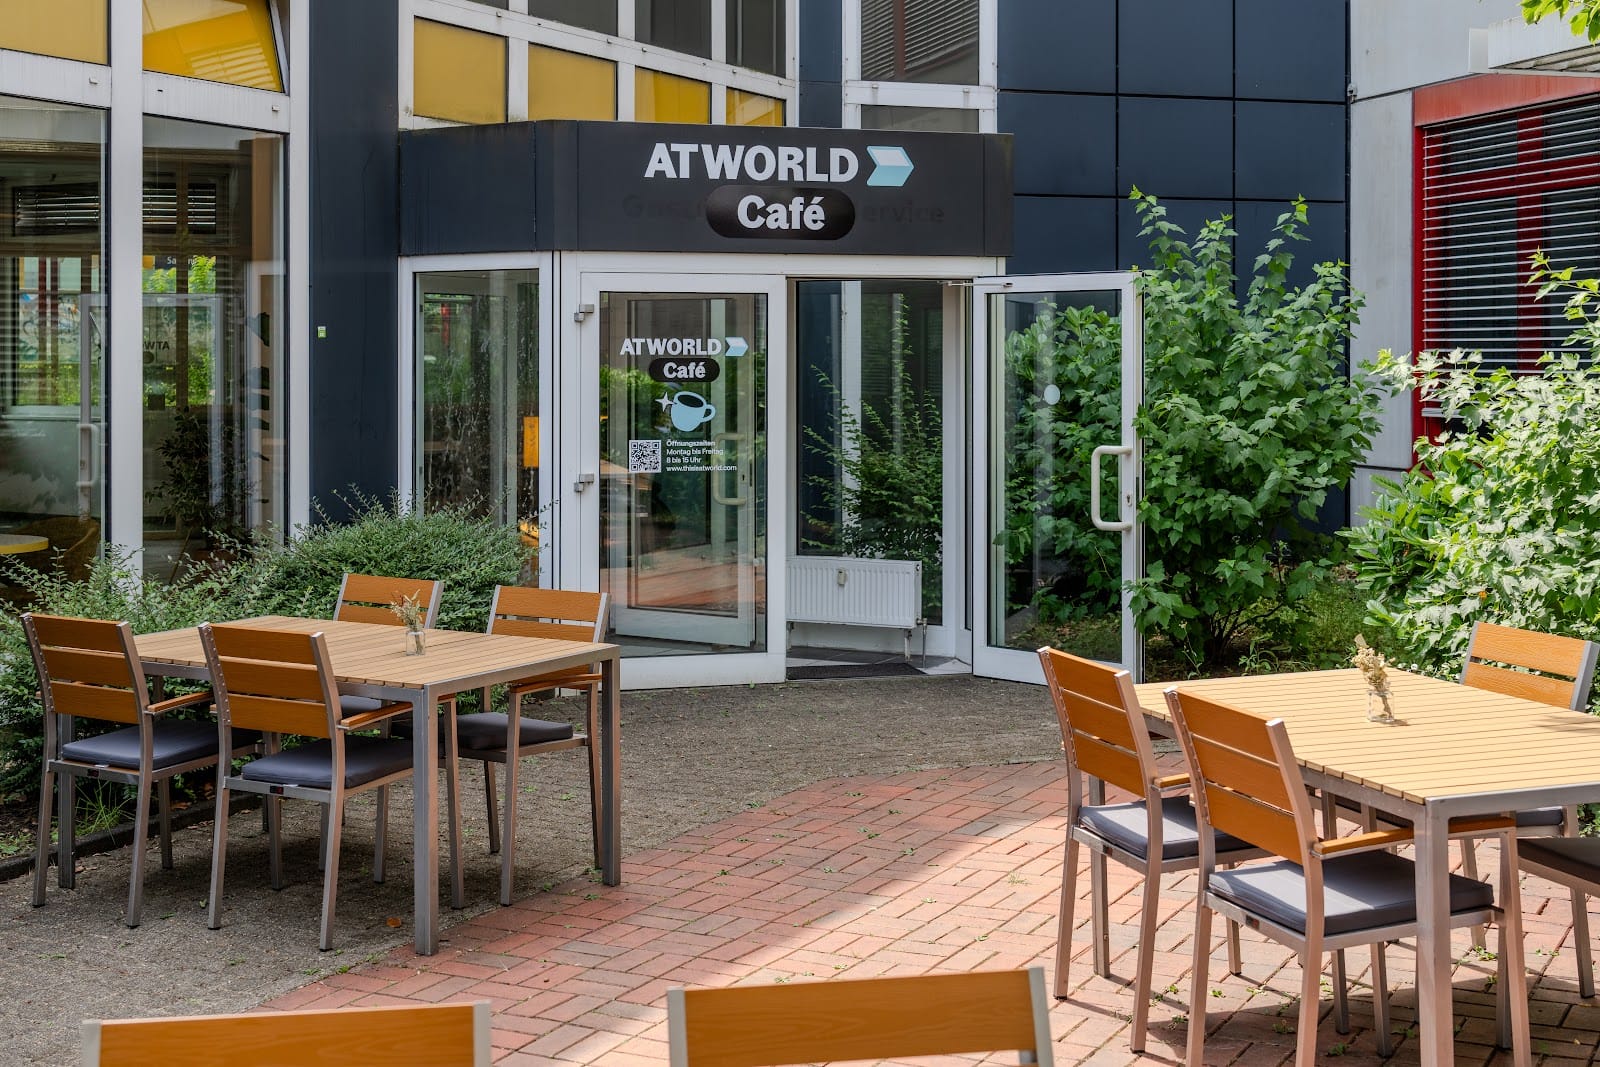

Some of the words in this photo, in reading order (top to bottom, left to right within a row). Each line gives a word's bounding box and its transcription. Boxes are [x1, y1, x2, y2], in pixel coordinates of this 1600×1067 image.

[737, 195, 825, 231] Café
[663, 361, 706, 379] Café
[666, 439, 716, 448] Öffnungszeiten
[666, 448, 691, 456] Montag
[702, 448, 724, 456] Freitag
